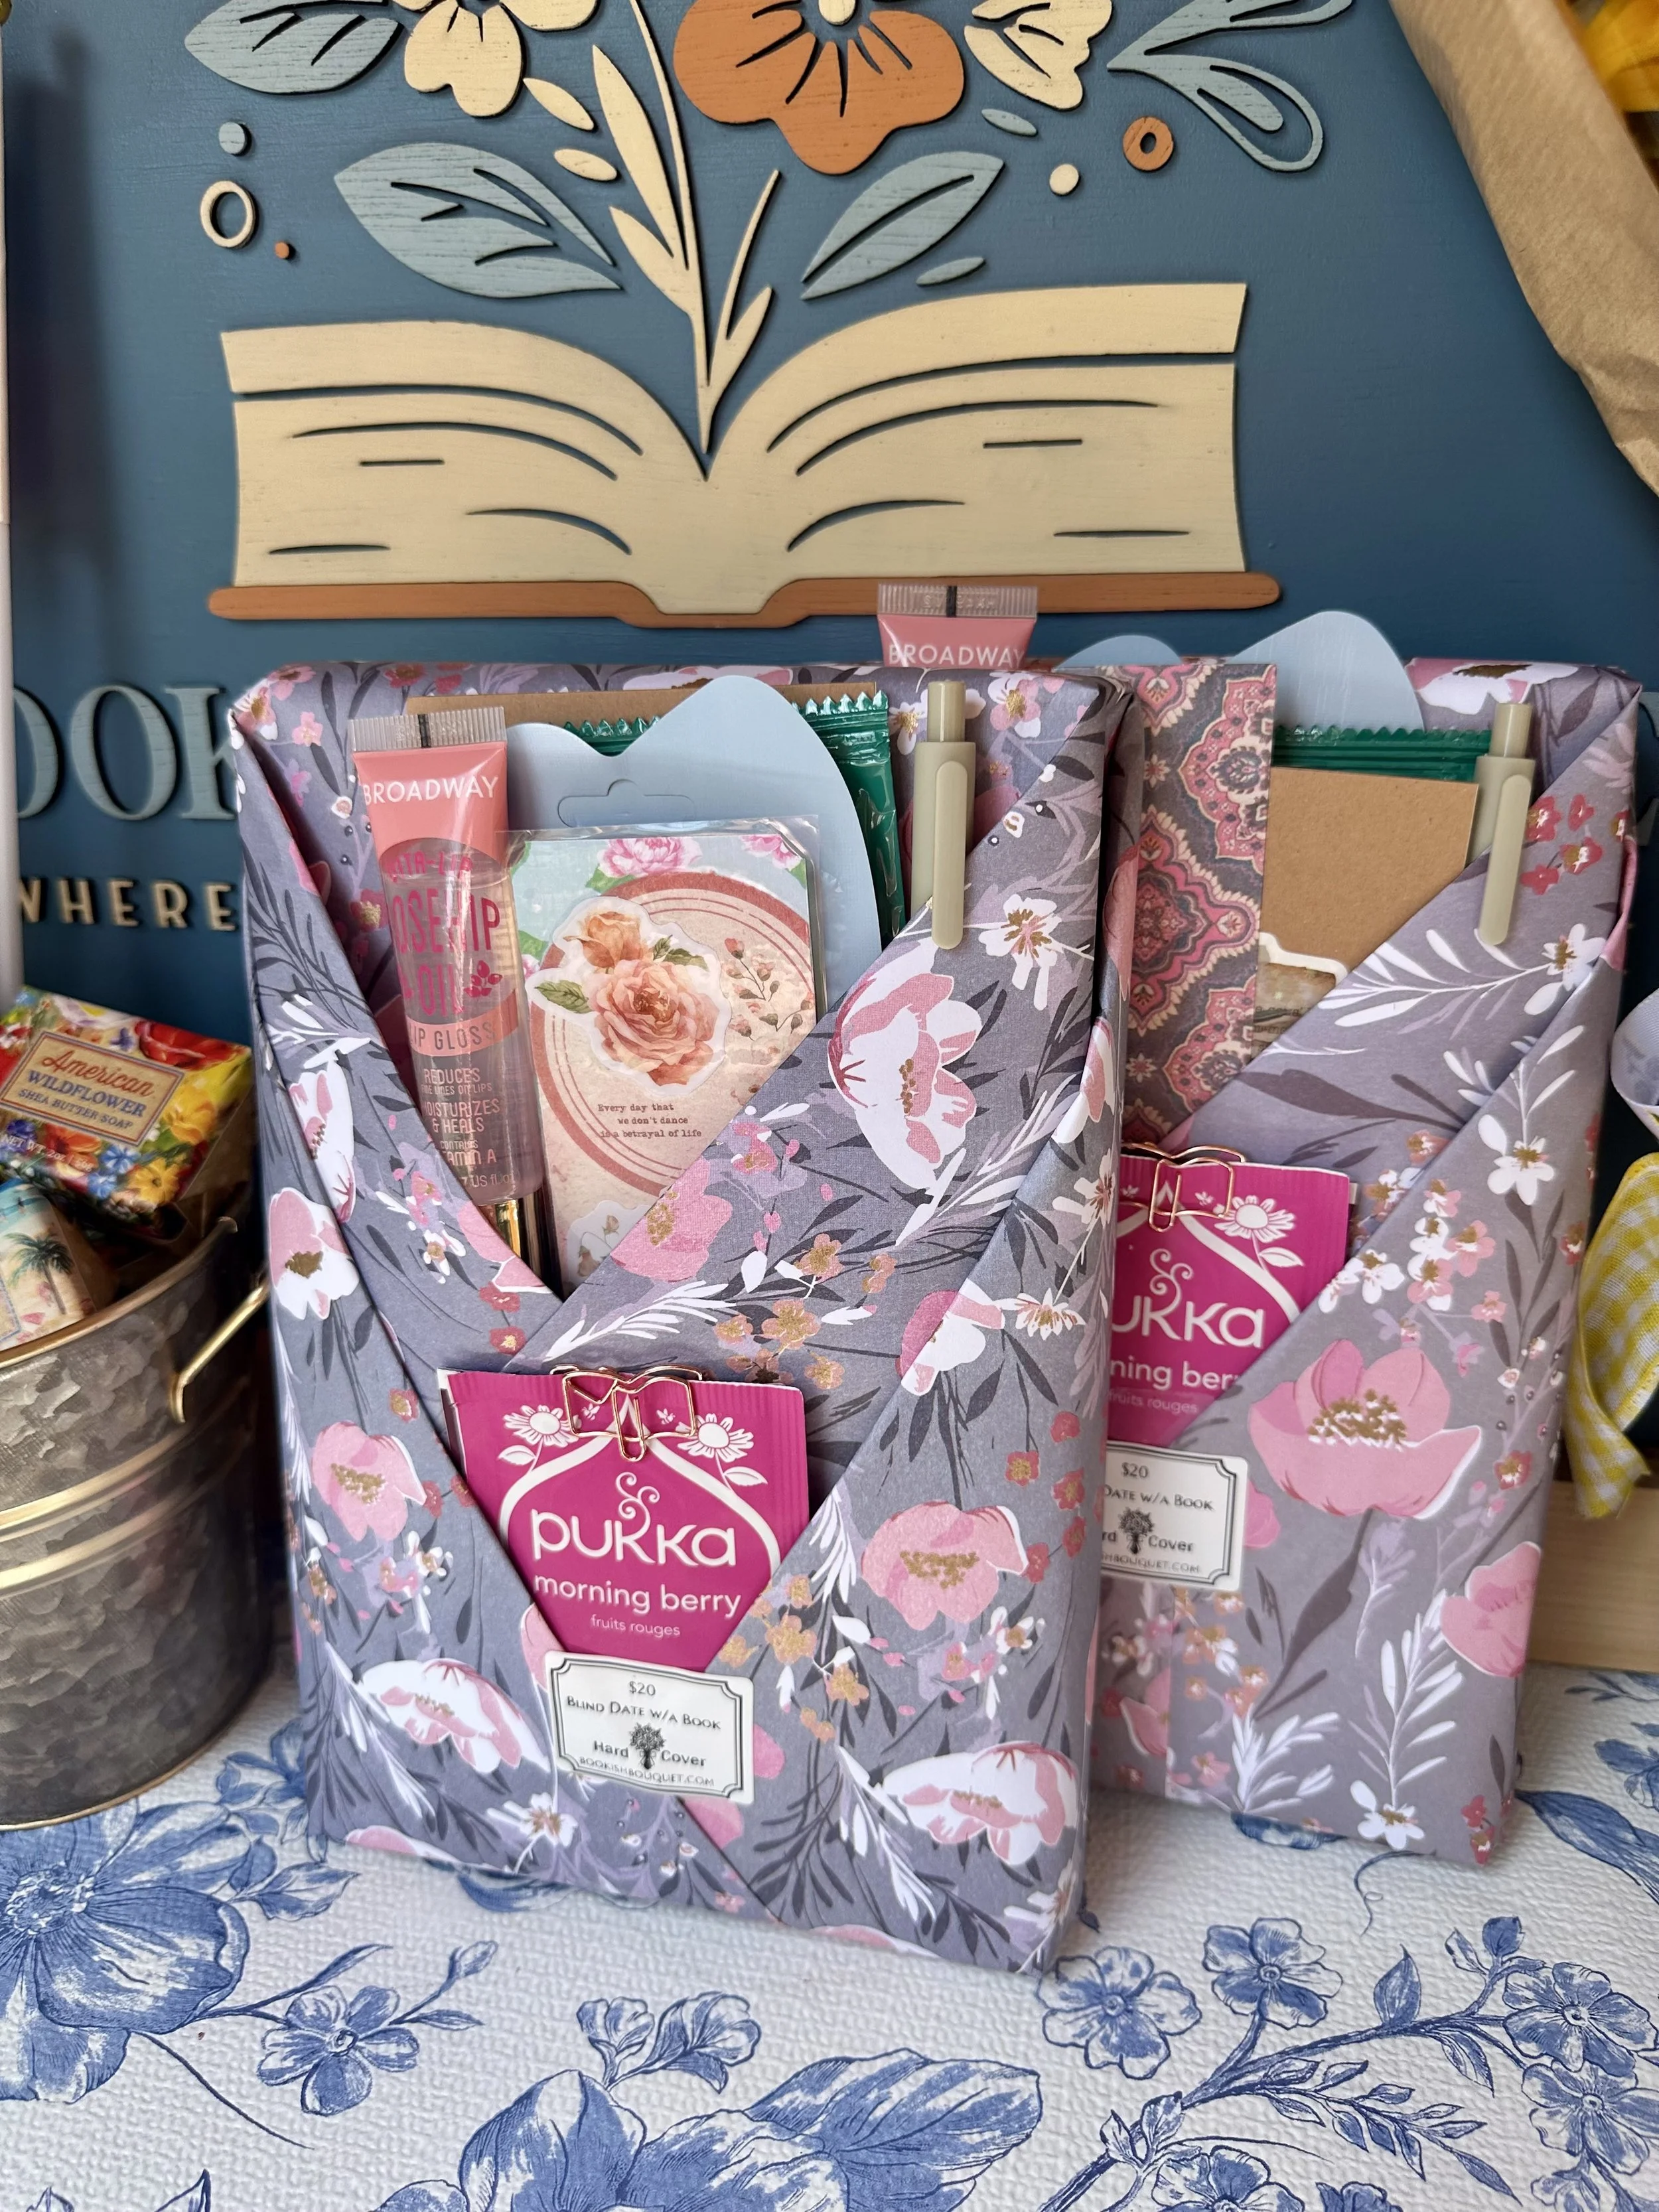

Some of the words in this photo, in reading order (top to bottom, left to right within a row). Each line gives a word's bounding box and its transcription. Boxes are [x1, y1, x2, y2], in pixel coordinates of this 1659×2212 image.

[889, 644, 1025, 667] BROADWAY
[363, 775, 499, 806] BROADWAY
[409, 1024, 426, 1047] LIP
[434, 1021, 496, 1051] GLOSS
[42, 1050, 155, 1097] American
[423, 1068, 481, 1084] REDUCES
[27, 1070, 147, 1118] WILDFLOWER
[473, 1082, 493, 1094] LIPS
[19, 1088, 49, 1106] SHEA
[52, 1098, 98, 1120] BUTTER
[100, 1114, 133, 1130] SOAP
[597, 1104, 626, 1113] Every
[630, 1104, 648, 1113] day
[443, 1116, 484, 1134] HEALS
[622, 1130, 665, 1139] betrayal
[487, 1148, 497, 1164] A
[472, 1173, 488, 1188] US
[1147, 1398, 1199, 1414] rouges
[1121, 1462, 1149, 1479] $20
[1148, 1534, 1194, 1552] Cover
[534, 1574, 651, 1615] morning
[660, 1583, 741, 1620] berry
[590, 1613, 626, 1631] fruits
[630, 1620, 680, 1638] rouges
[628, 1680, 656, 1696] $20
[593, 1739, 629, 1758] Hard
[660, 1749, 707, 1767] Cover
